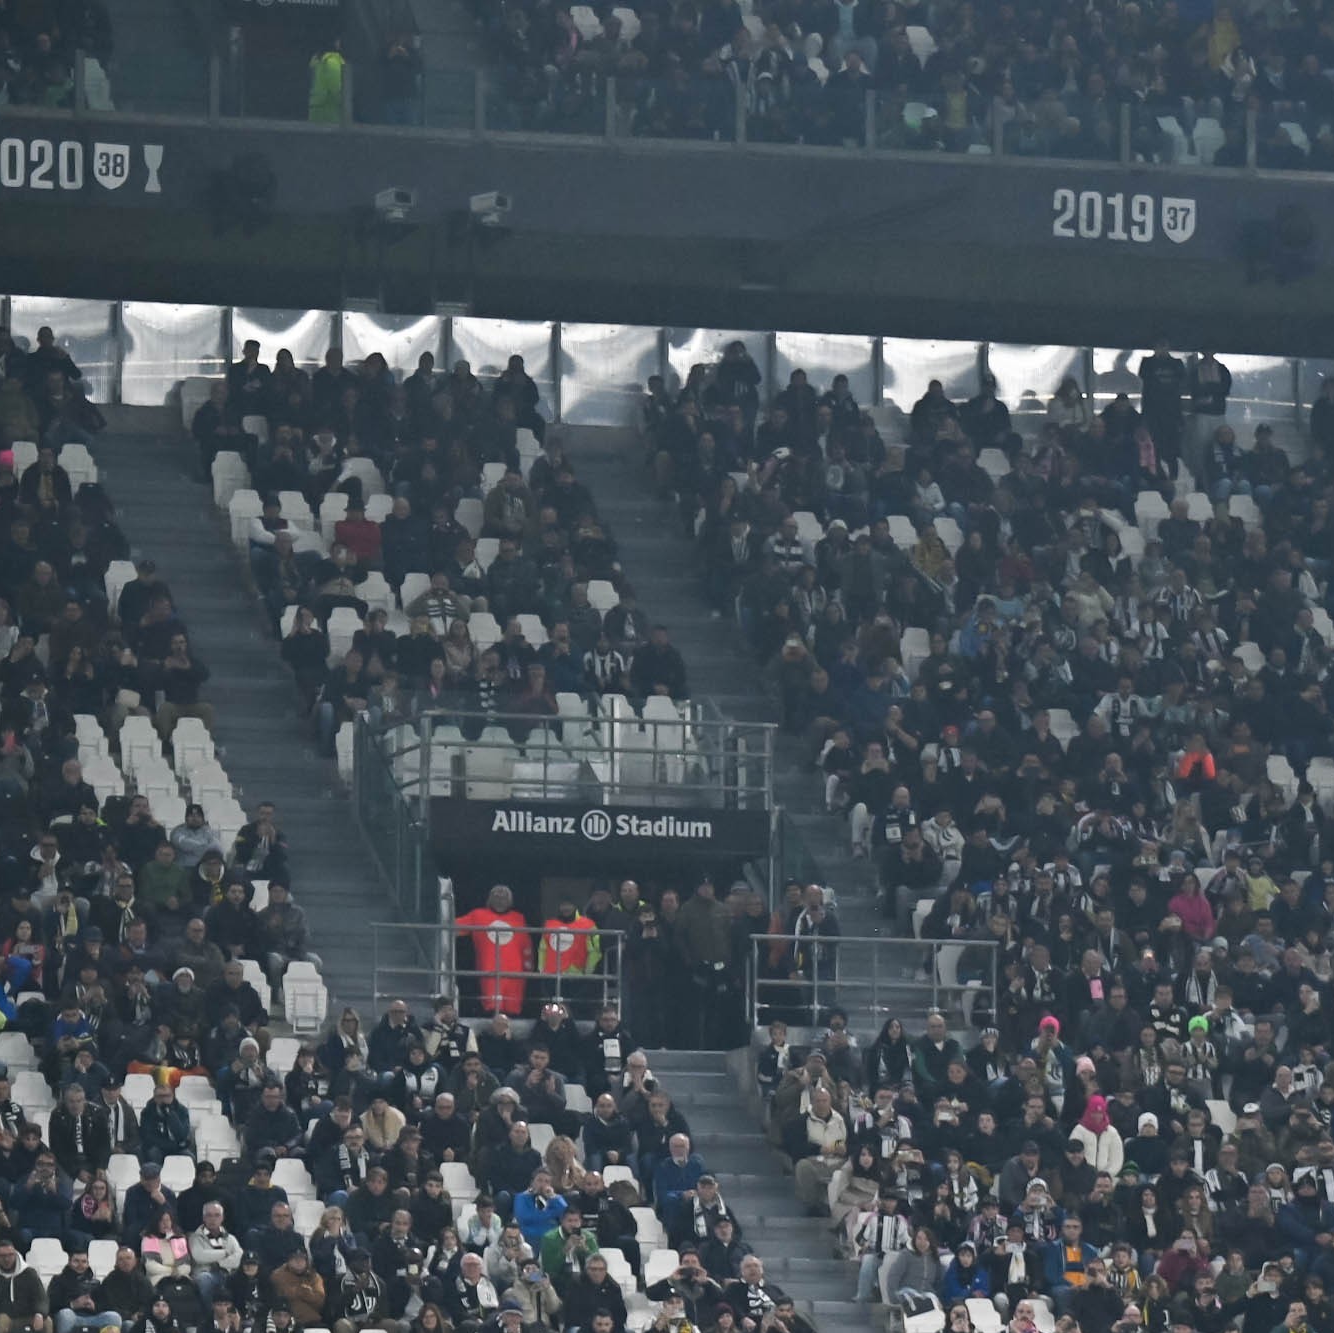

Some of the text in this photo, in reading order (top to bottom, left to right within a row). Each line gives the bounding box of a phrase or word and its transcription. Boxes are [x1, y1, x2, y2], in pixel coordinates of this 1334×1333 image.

[98, 151, 125, 178] 38
[1052, 188, 1191, 243] 2019 37
[491, 810, 713, 838] Allianz Stadium
